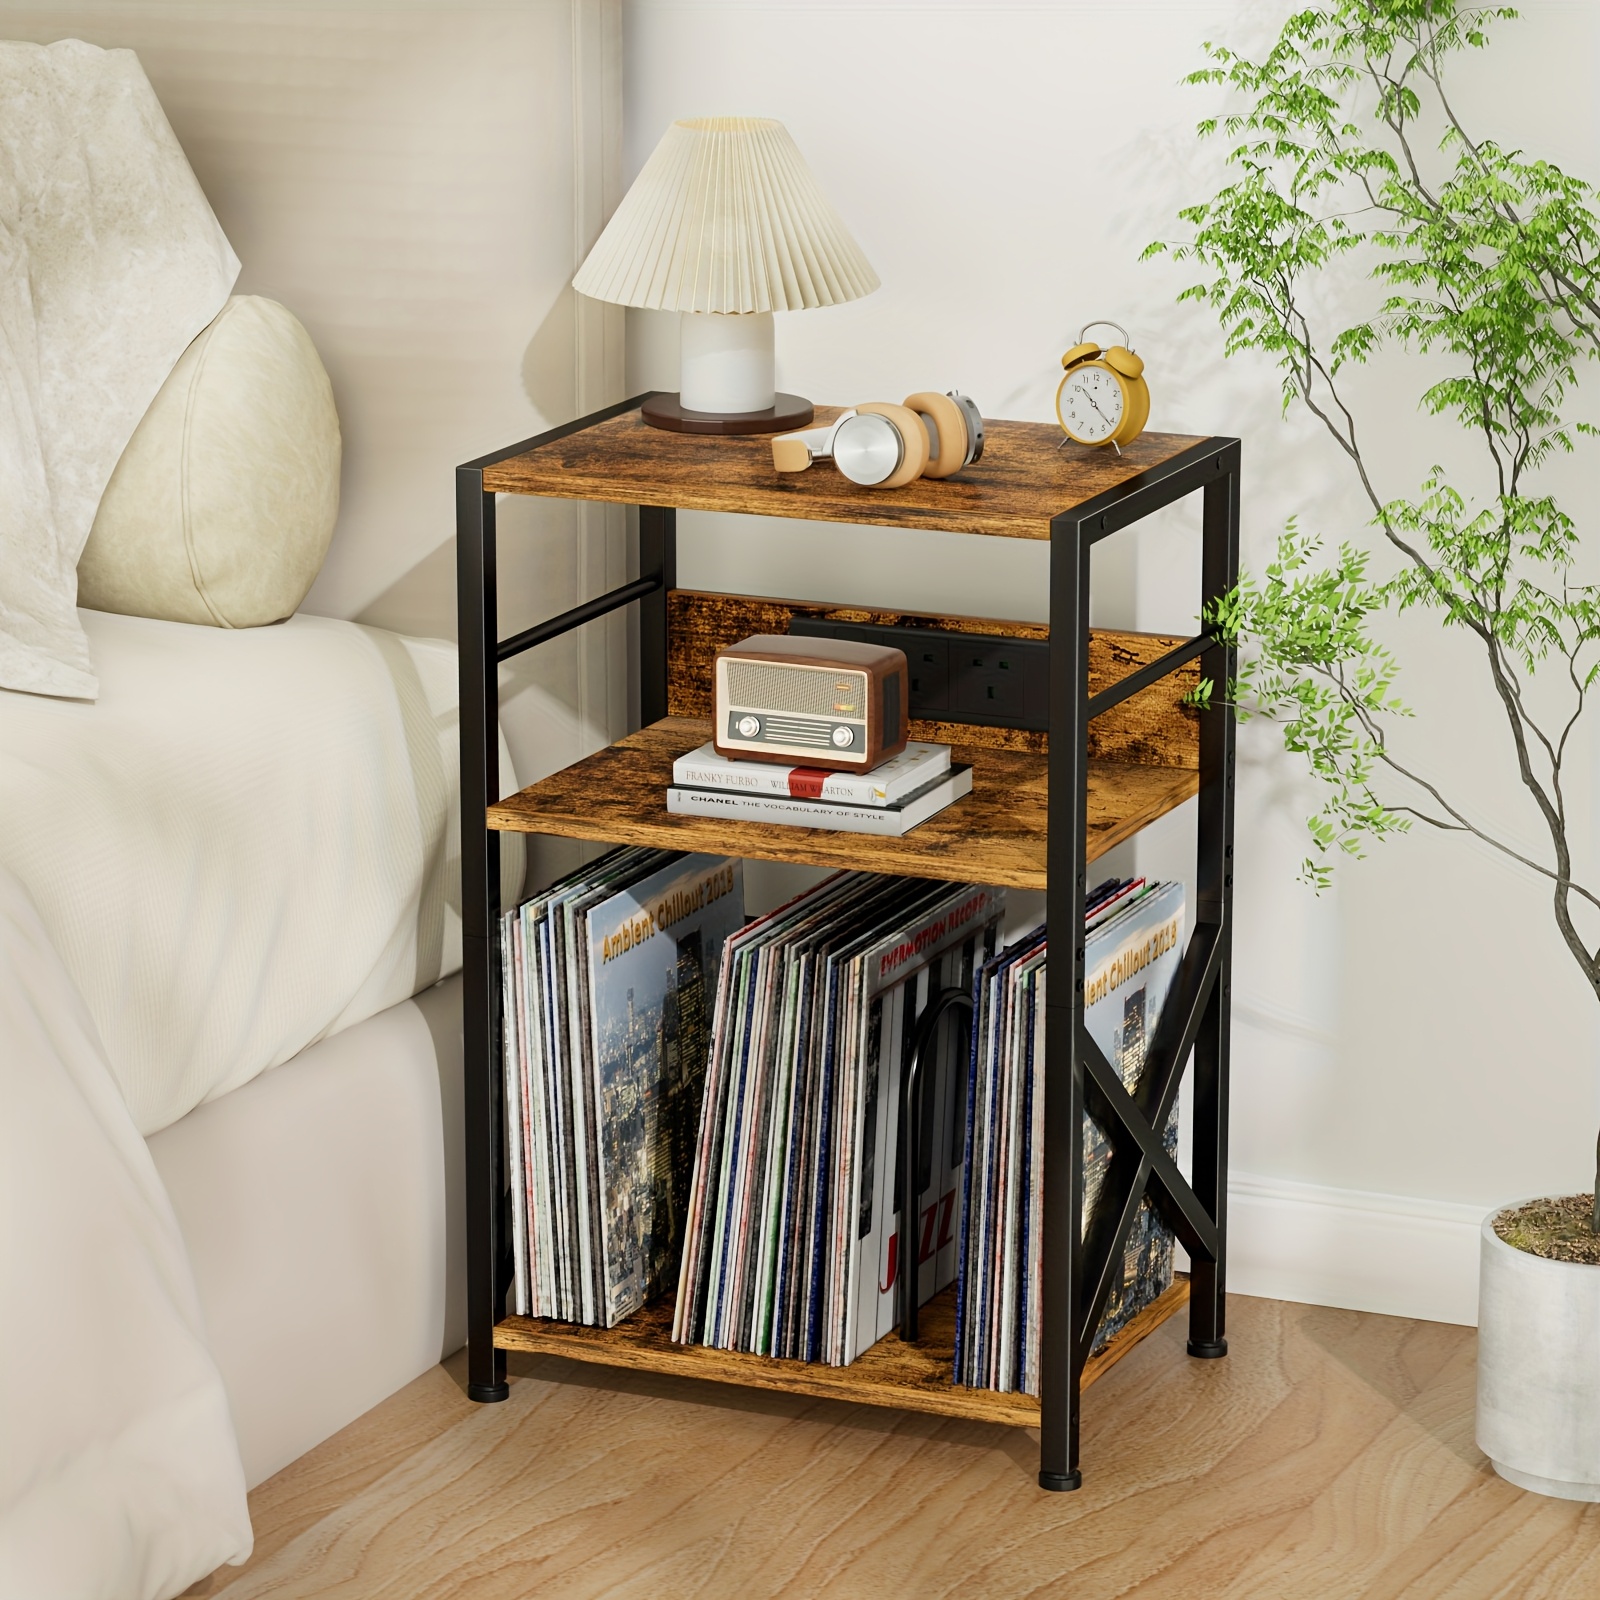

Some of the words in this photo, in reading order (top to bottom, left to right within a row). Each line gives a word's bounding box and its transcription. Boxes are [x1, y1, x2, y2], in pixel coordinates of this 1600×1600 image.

[1074, 384, 1081, 392] 10
[1082, 374, 1089, 384] 11
[1093, 373, 1100, 382] 12
[1077, 421, 1084, 430] 7
[686, 770, 724, 783] FRANKY
[726, 774, 759, 787] FURBO
[770, 780, 807, 792] WILLIAM
[809, 784, 854, 796] WHARTON
[691, 796, 738, 806] CHANEL
[764, 803, 833, 815] VOCABULARY
[854, 812, 885, 821] STYLE
[602, 911, 656, 966] Ambient
[656, 883, 705, 932] Chillout
[706, 865, 734, 906] 2018
[880, 916, 947, 978] EVERMOTION
[1110, 943, 1151, 992] Chillout
[1152, 920, 1178, 962] 2018
[879, 1187, 957, 1295] JZZ
